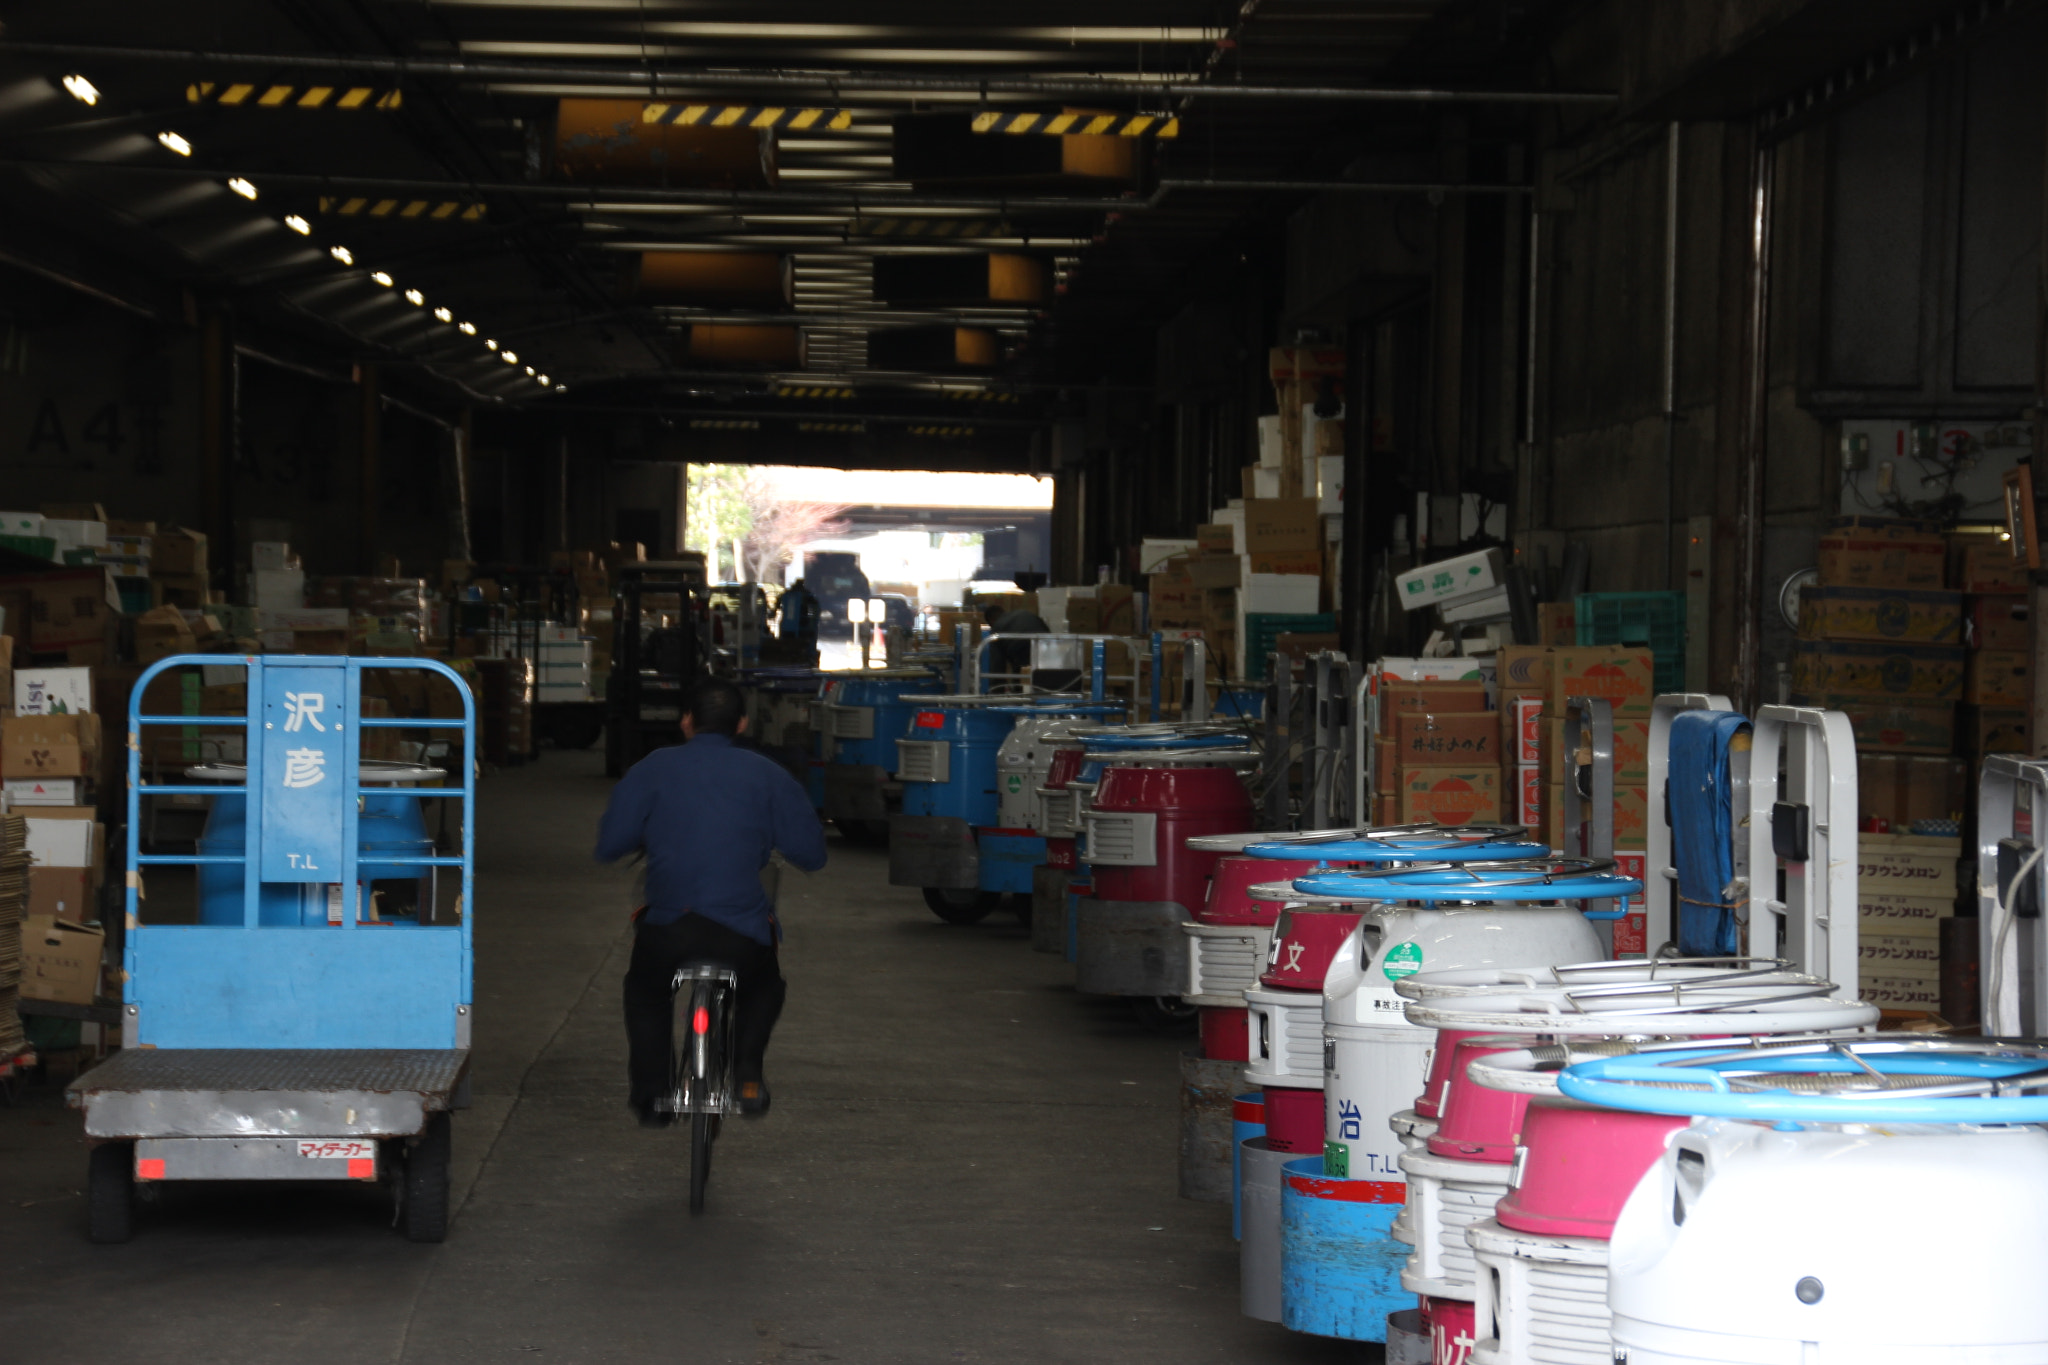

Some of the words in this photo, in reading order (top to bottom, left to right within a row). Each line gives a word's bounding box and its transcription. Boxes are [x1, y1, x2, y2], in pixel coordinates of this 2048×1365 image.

[283, 691, 326, 788] 沢彦
[287, 854, 319, 870] T.L
[1858, 904, 1938, 919] ラウンメロン
[1283, 940, 1306, 973] 文
[1366, 1153, 1398, 1174] T.L
